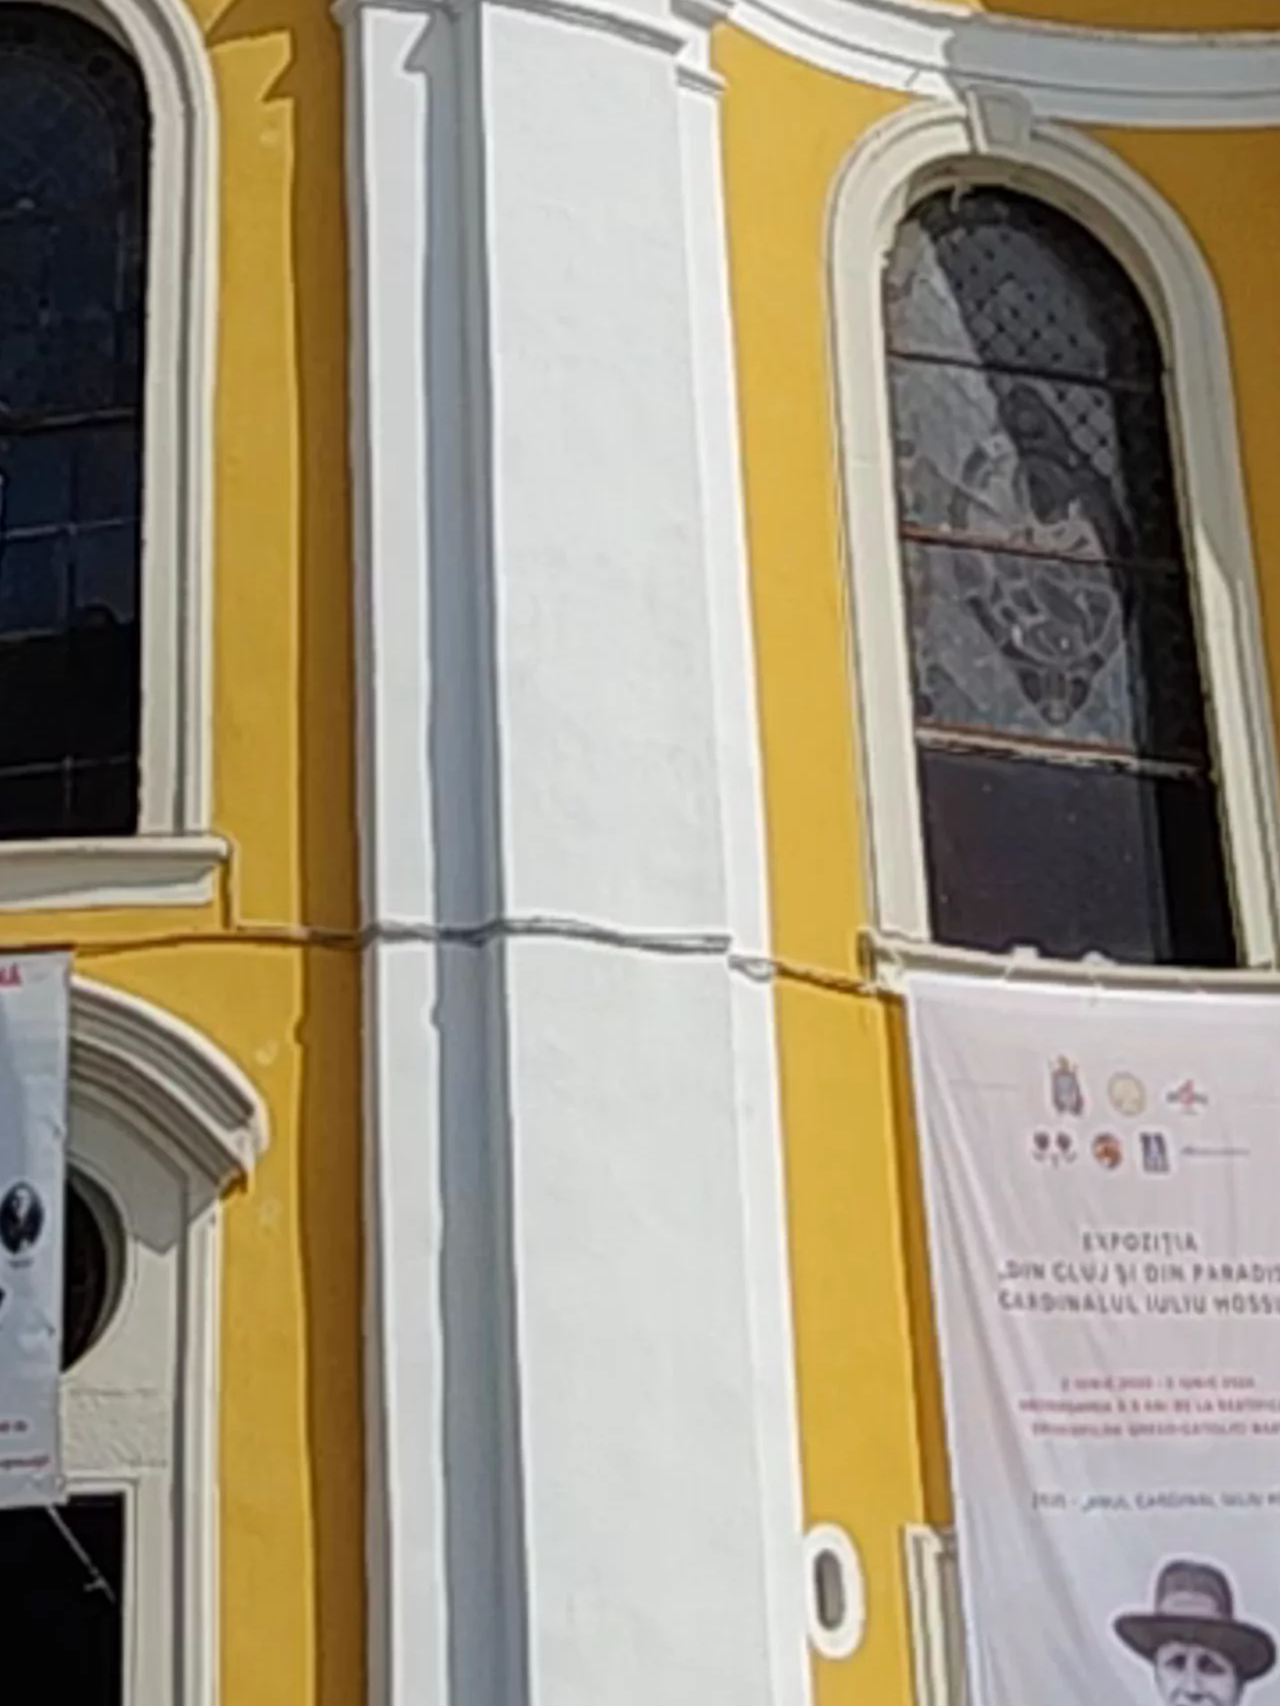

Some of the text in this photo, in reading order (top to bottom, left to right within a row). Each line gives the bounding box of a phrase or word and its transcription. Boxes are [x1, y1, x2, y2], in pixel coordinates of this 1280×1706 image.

[1052, 1260, 1109, 1283] CLUJ
[1144, 1263, 1185, 1283] DIN
[998, 1289, 1140, 1315] CARDINALUL
[1146, 1295, 1206, 1314] IULIU
